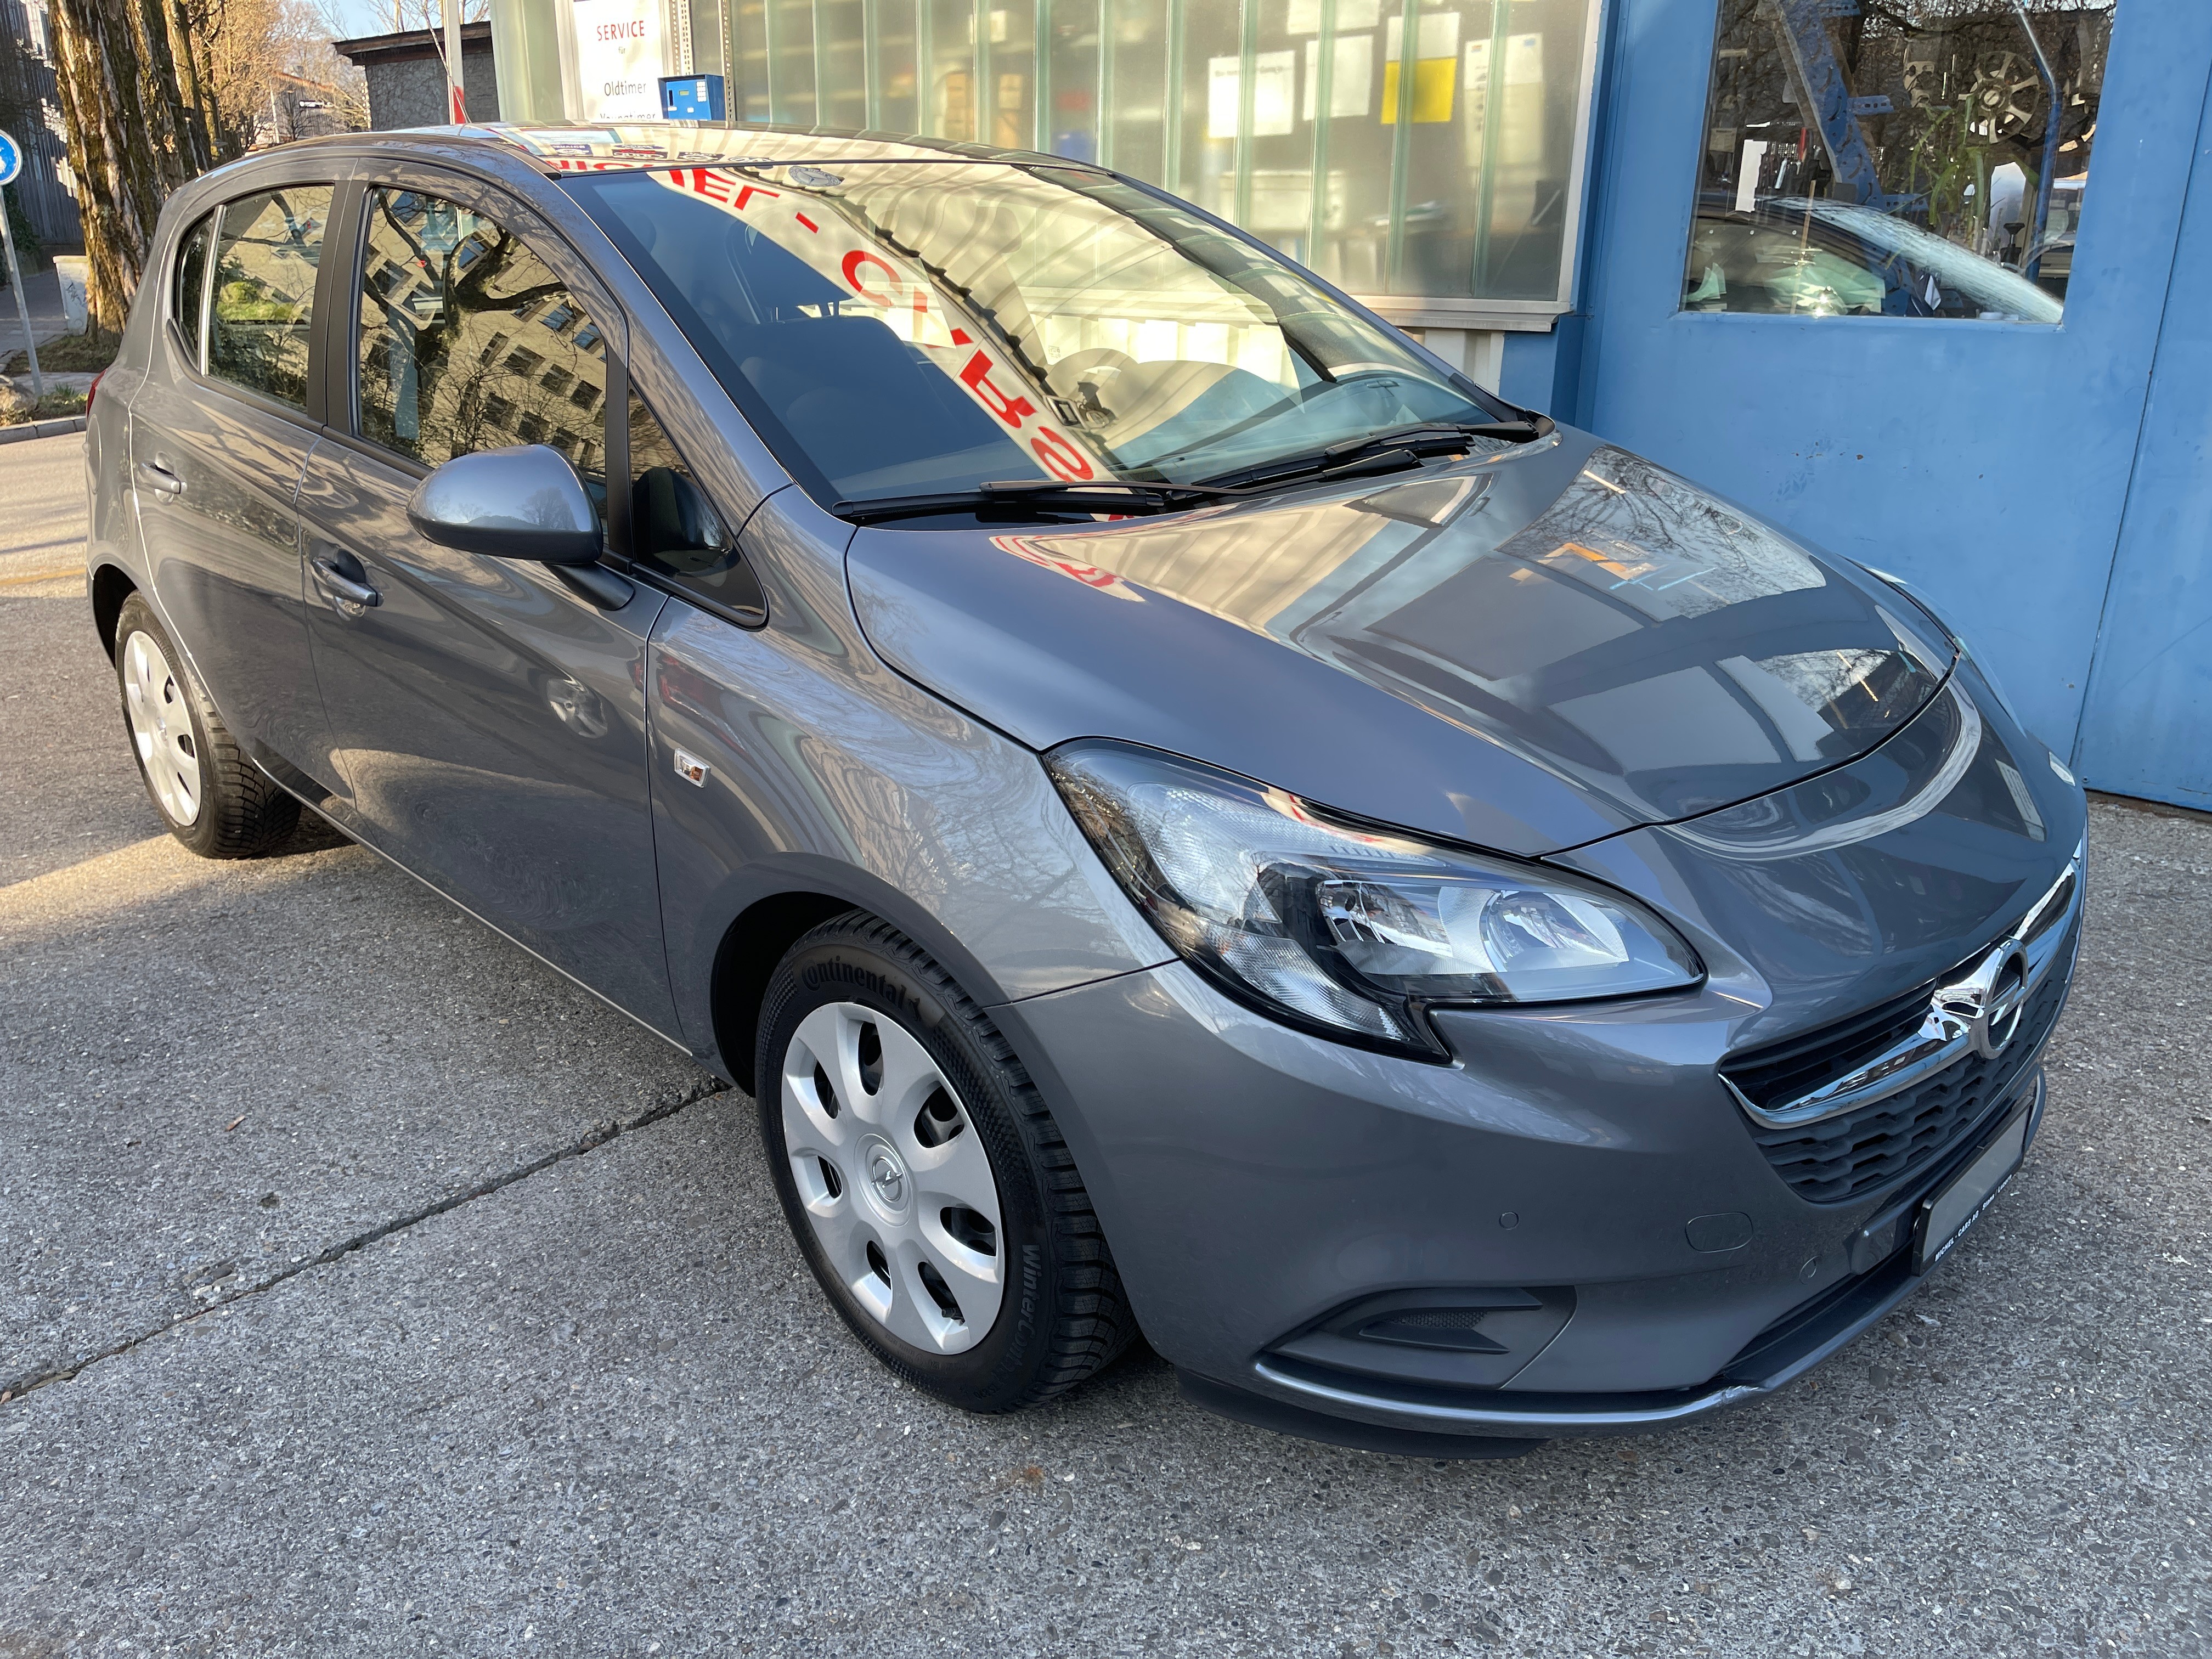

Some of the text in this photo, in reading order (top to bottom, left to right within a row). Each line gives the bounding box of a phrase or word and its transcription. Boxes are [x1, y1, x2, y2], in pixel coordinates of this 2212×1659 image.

[597, 20, 645, 41] SERVICE
[604, 81, 646, 96] Oldtimer
[802, 955, 907, 1012] Continental
[1935, 1237, 1954, 1261] MICHEL
[1958, 1218, 1971, 1237] CARS
[1972, 1210, 1979, 1223] AG
